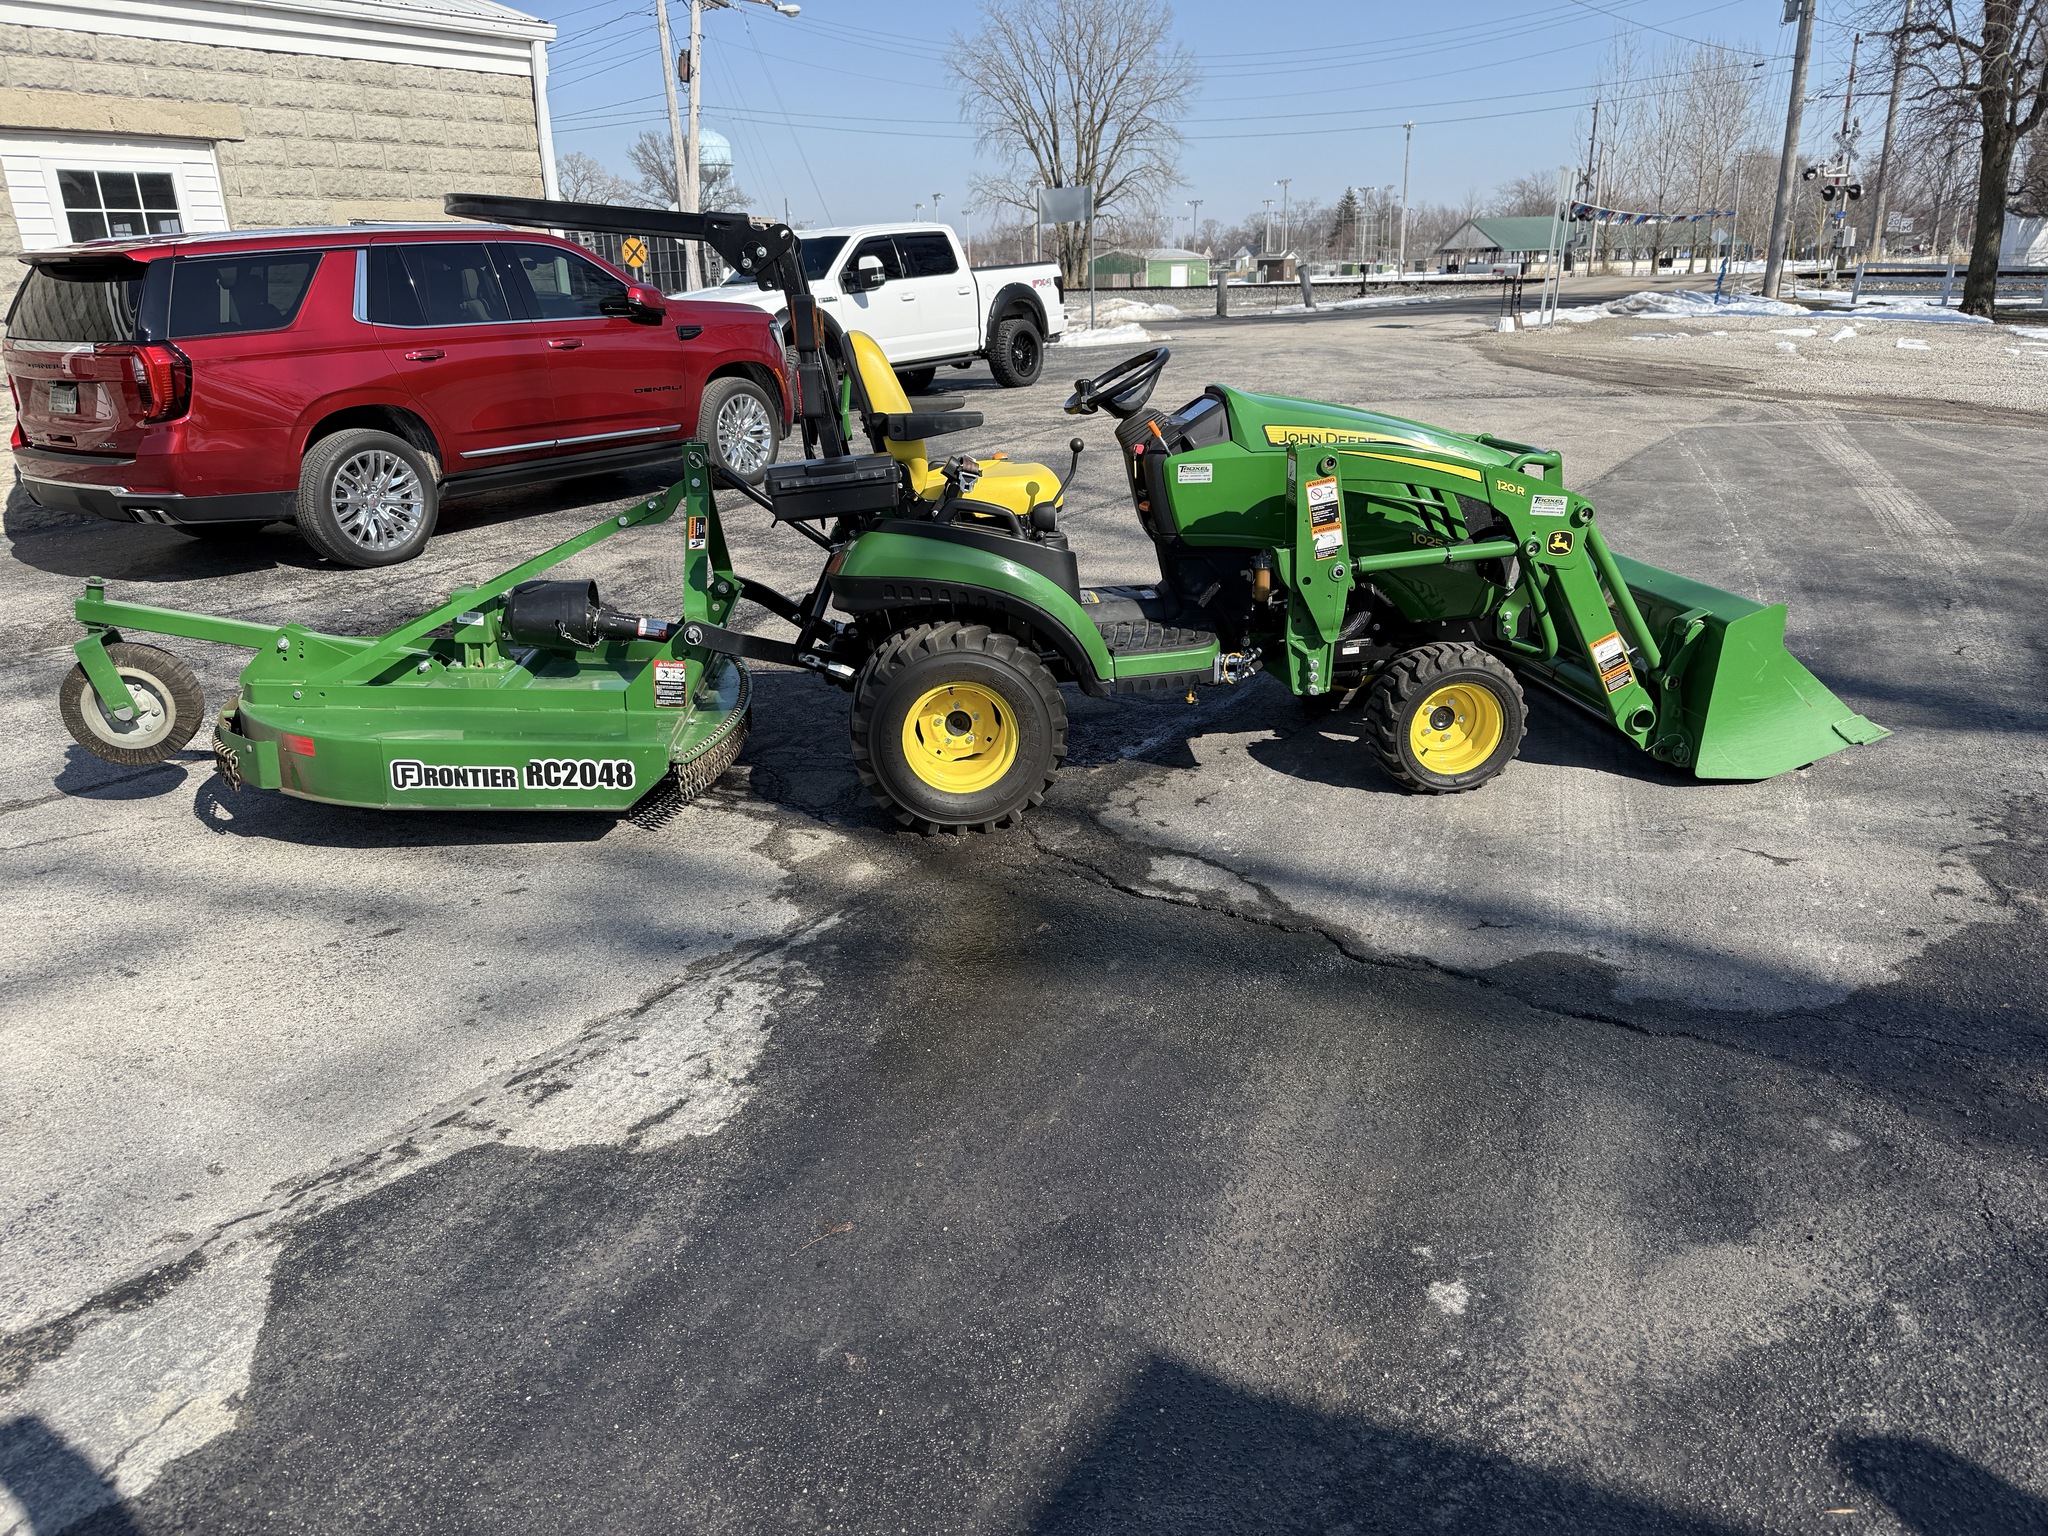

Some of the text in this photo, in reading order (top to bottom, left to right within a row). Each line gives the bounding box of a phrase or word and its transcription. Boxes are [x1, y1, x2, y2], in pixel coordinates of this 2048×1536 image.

[625, 249, 645, 257] R R
[634, 385, 682, 393] DENALI
[1279, 431, 1377, 444] JOHN DEER
[1179, 465, 1209, 473] TROXEL
[1312, 477, 1335, 486] WARNING
[1496, 479, 1526, 497] 120 R
[1534, 496, 1564, 505] TROXEL
[1412, 532, 1451, 547] 1025
[392, 760, 633, 789] FRONTIER RC2048
